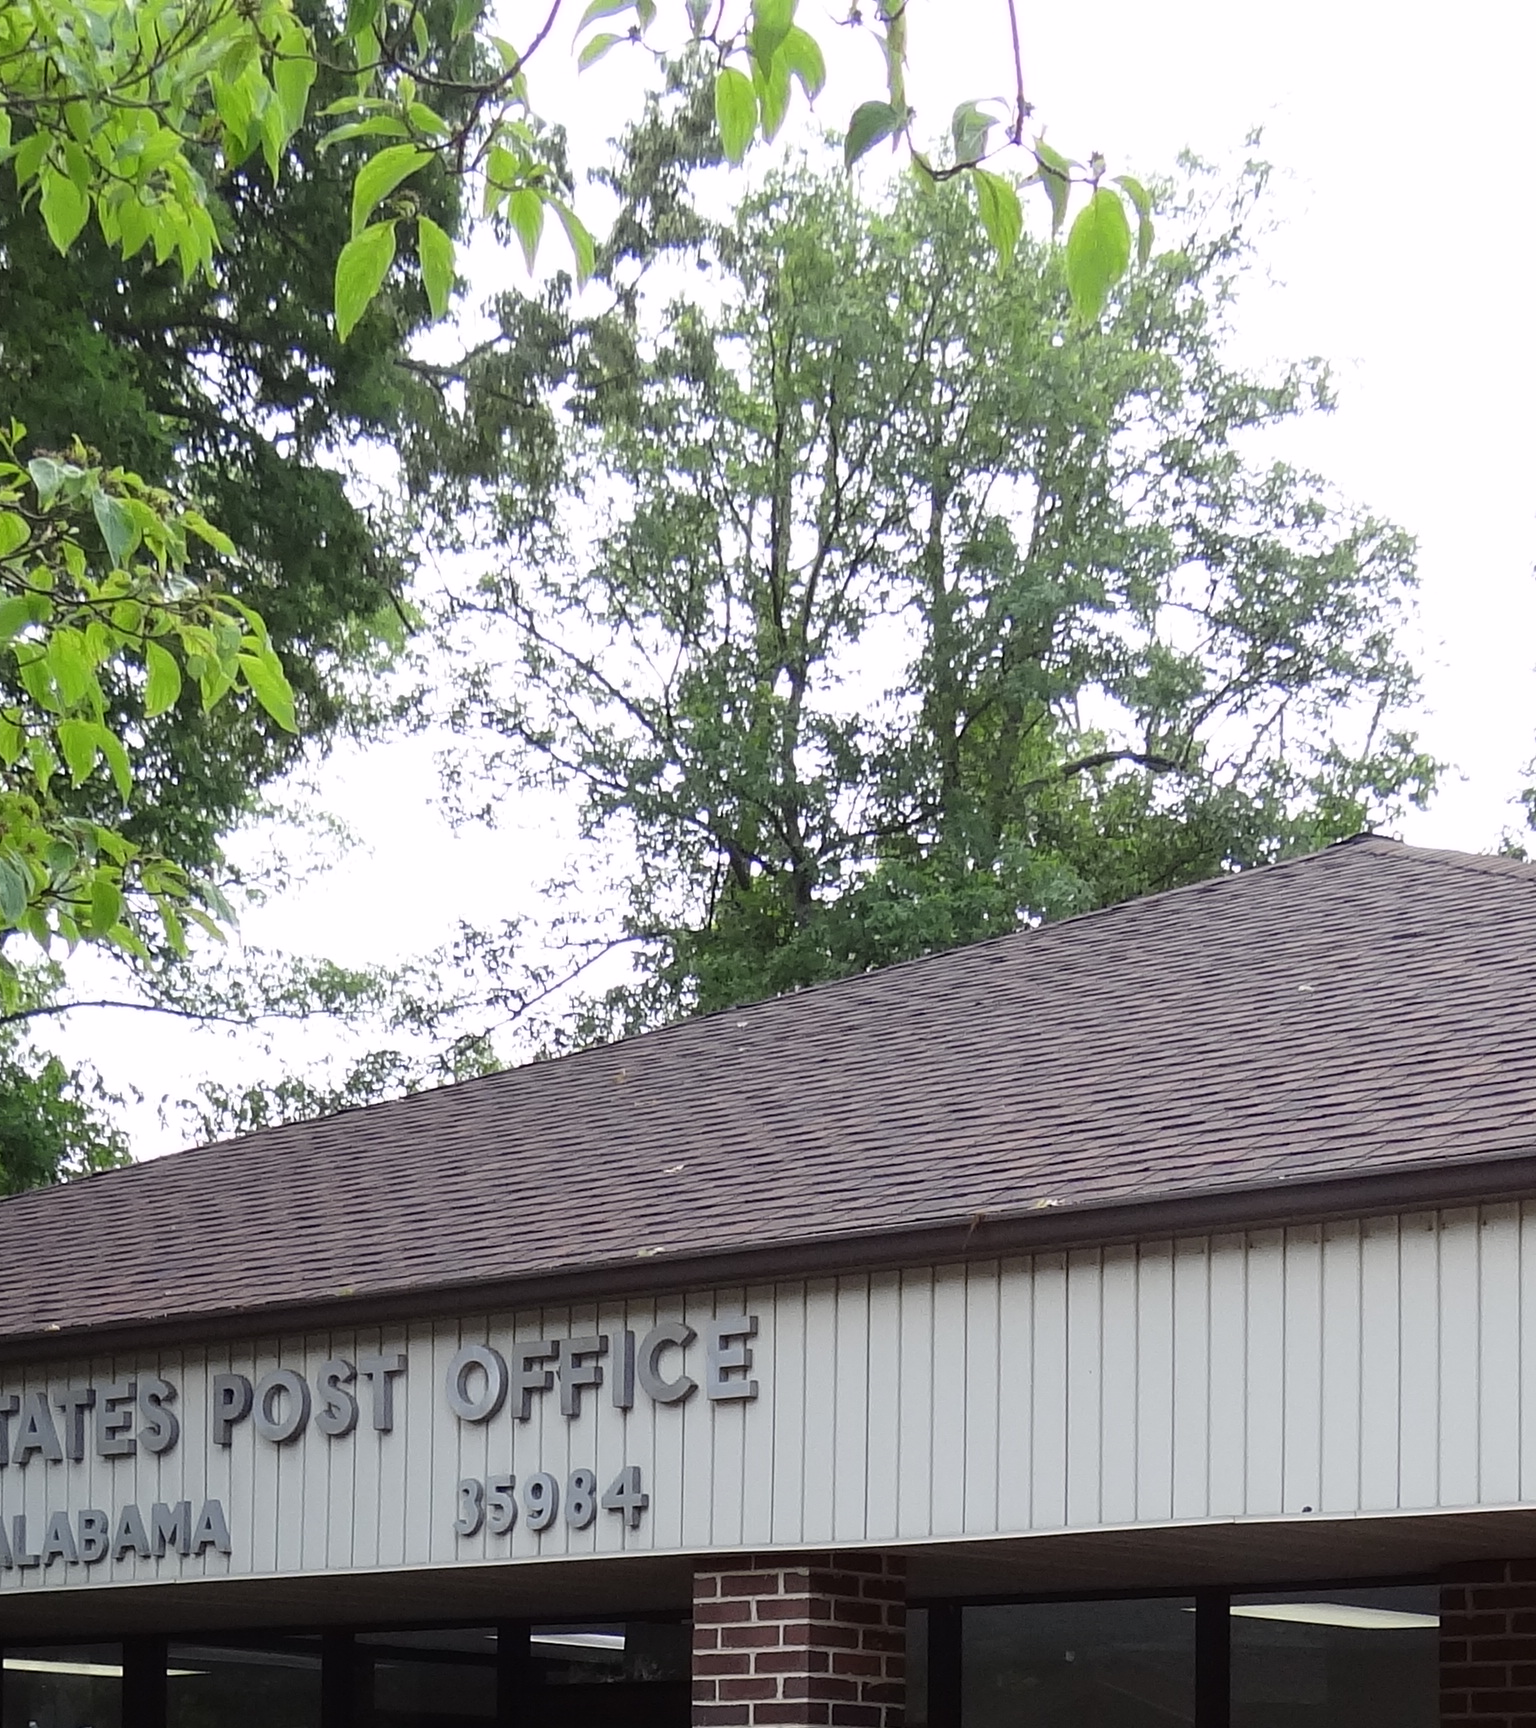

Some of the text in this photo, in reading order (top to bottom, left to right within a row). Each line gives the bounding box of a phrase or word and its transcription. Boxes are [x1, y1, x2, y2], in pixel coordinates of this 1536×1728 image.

[213, 1353, 407, 1445] POST
[445, 1315, 758, 1423] OFFICE
[454, 1466, 649, 1537] 35984
